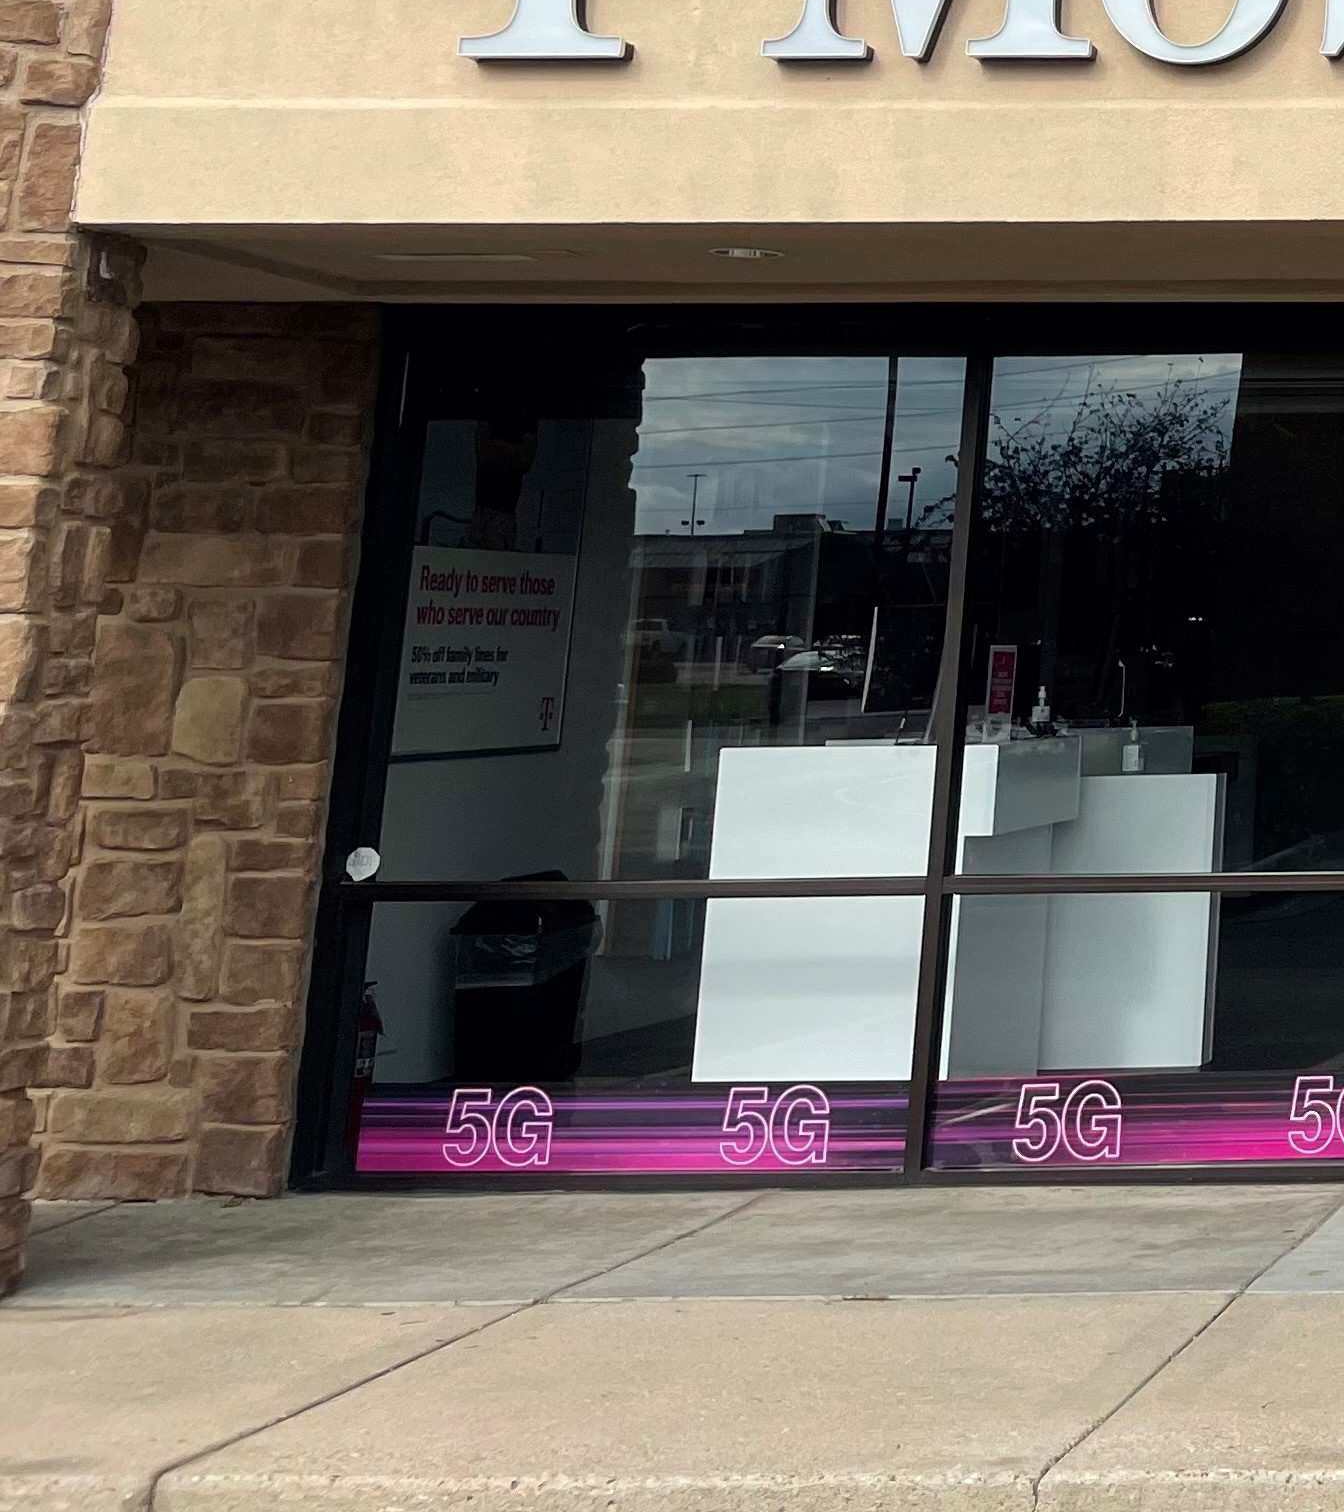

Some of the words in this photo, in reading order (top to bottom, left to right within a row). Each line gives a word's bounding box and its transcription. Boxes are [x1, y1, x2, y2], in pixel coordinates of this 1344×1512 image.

[420, 565, 463, 597] Ready
[466, 570, 478, 593] to
[481, 575, 516, 594] serve
[520, 570, 556, 595] those
[416, 600, 445, 625] who
[447, 605, 484, 626] serve
[487, 607, 510, 626] our
[511, 606, 561, 632] country
[448, 667, 465, 684] and
[442, 1086, 553, 1166] 5G
[720, 1084, 830, 1165] 5G
[1013, 1080, 1122, 1162] 5G
